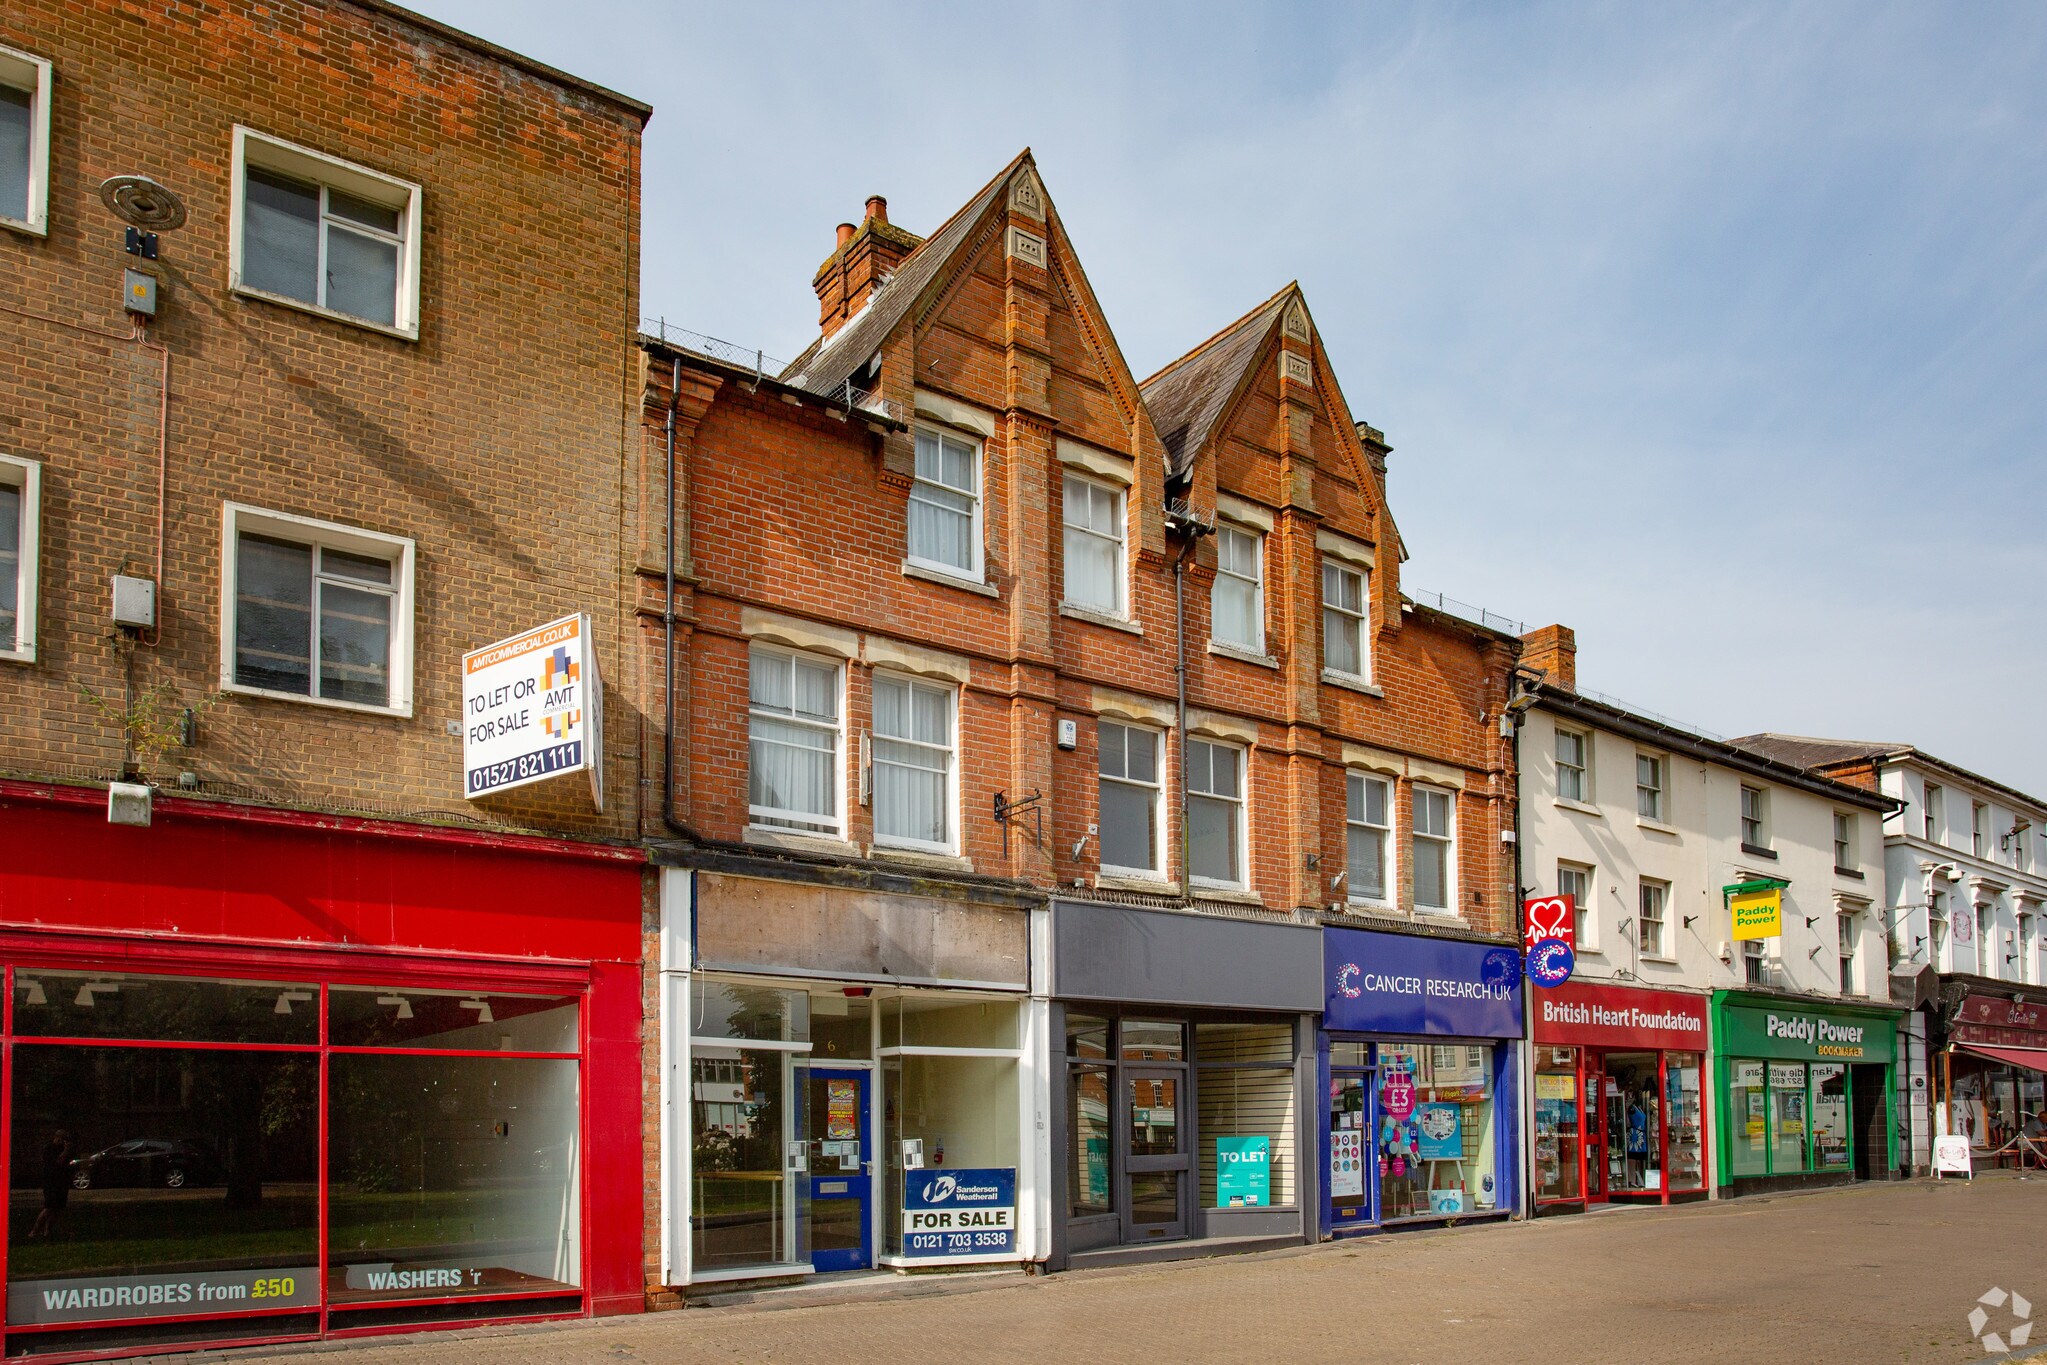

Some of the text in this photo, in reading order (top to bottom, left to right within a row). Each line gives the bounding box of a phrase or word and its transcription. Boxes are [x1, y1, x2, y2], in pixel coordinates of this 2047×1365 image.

[472, 624, 572, 670] AMTCOMMERCIAL.CO.UK
[468, 678, 536, 716] TO LET OR
[544, 686, 574, 708] AMT
[542, 702, 576, 716] COMMERCIAL
[470, 709, 530, 745] FOR SALE
[472, 744, 576, 790] 01527 821 111
[1737, 906, 1775, 917] Paddy
[1737, 916, 1776, 926] Power
[1364, 974, 1512, 1000] CANCER RESEARCH UK
[1544, 1000, 1701, 1032] British Heart Foundation
[1767, 1014, 1864, 1044] Paddy Power
[828, 1040, 836, 1052] 6
[1391, 1088, 1409, 1107] £3
[1220, 1152, 1266, 1162] TO LET
[956, 1186, 998, 1194] Sanderson
[956, 1193, 998, 1201] Weatherall
[912, 1212, 1007, 1228] FOR SALE
[913, 1232, 1007, 1248] 0121 703 3538
[368, 1268, 462, 1290] WASHERS
[44, 1277, 295, 1310] WARDROBES from £50
